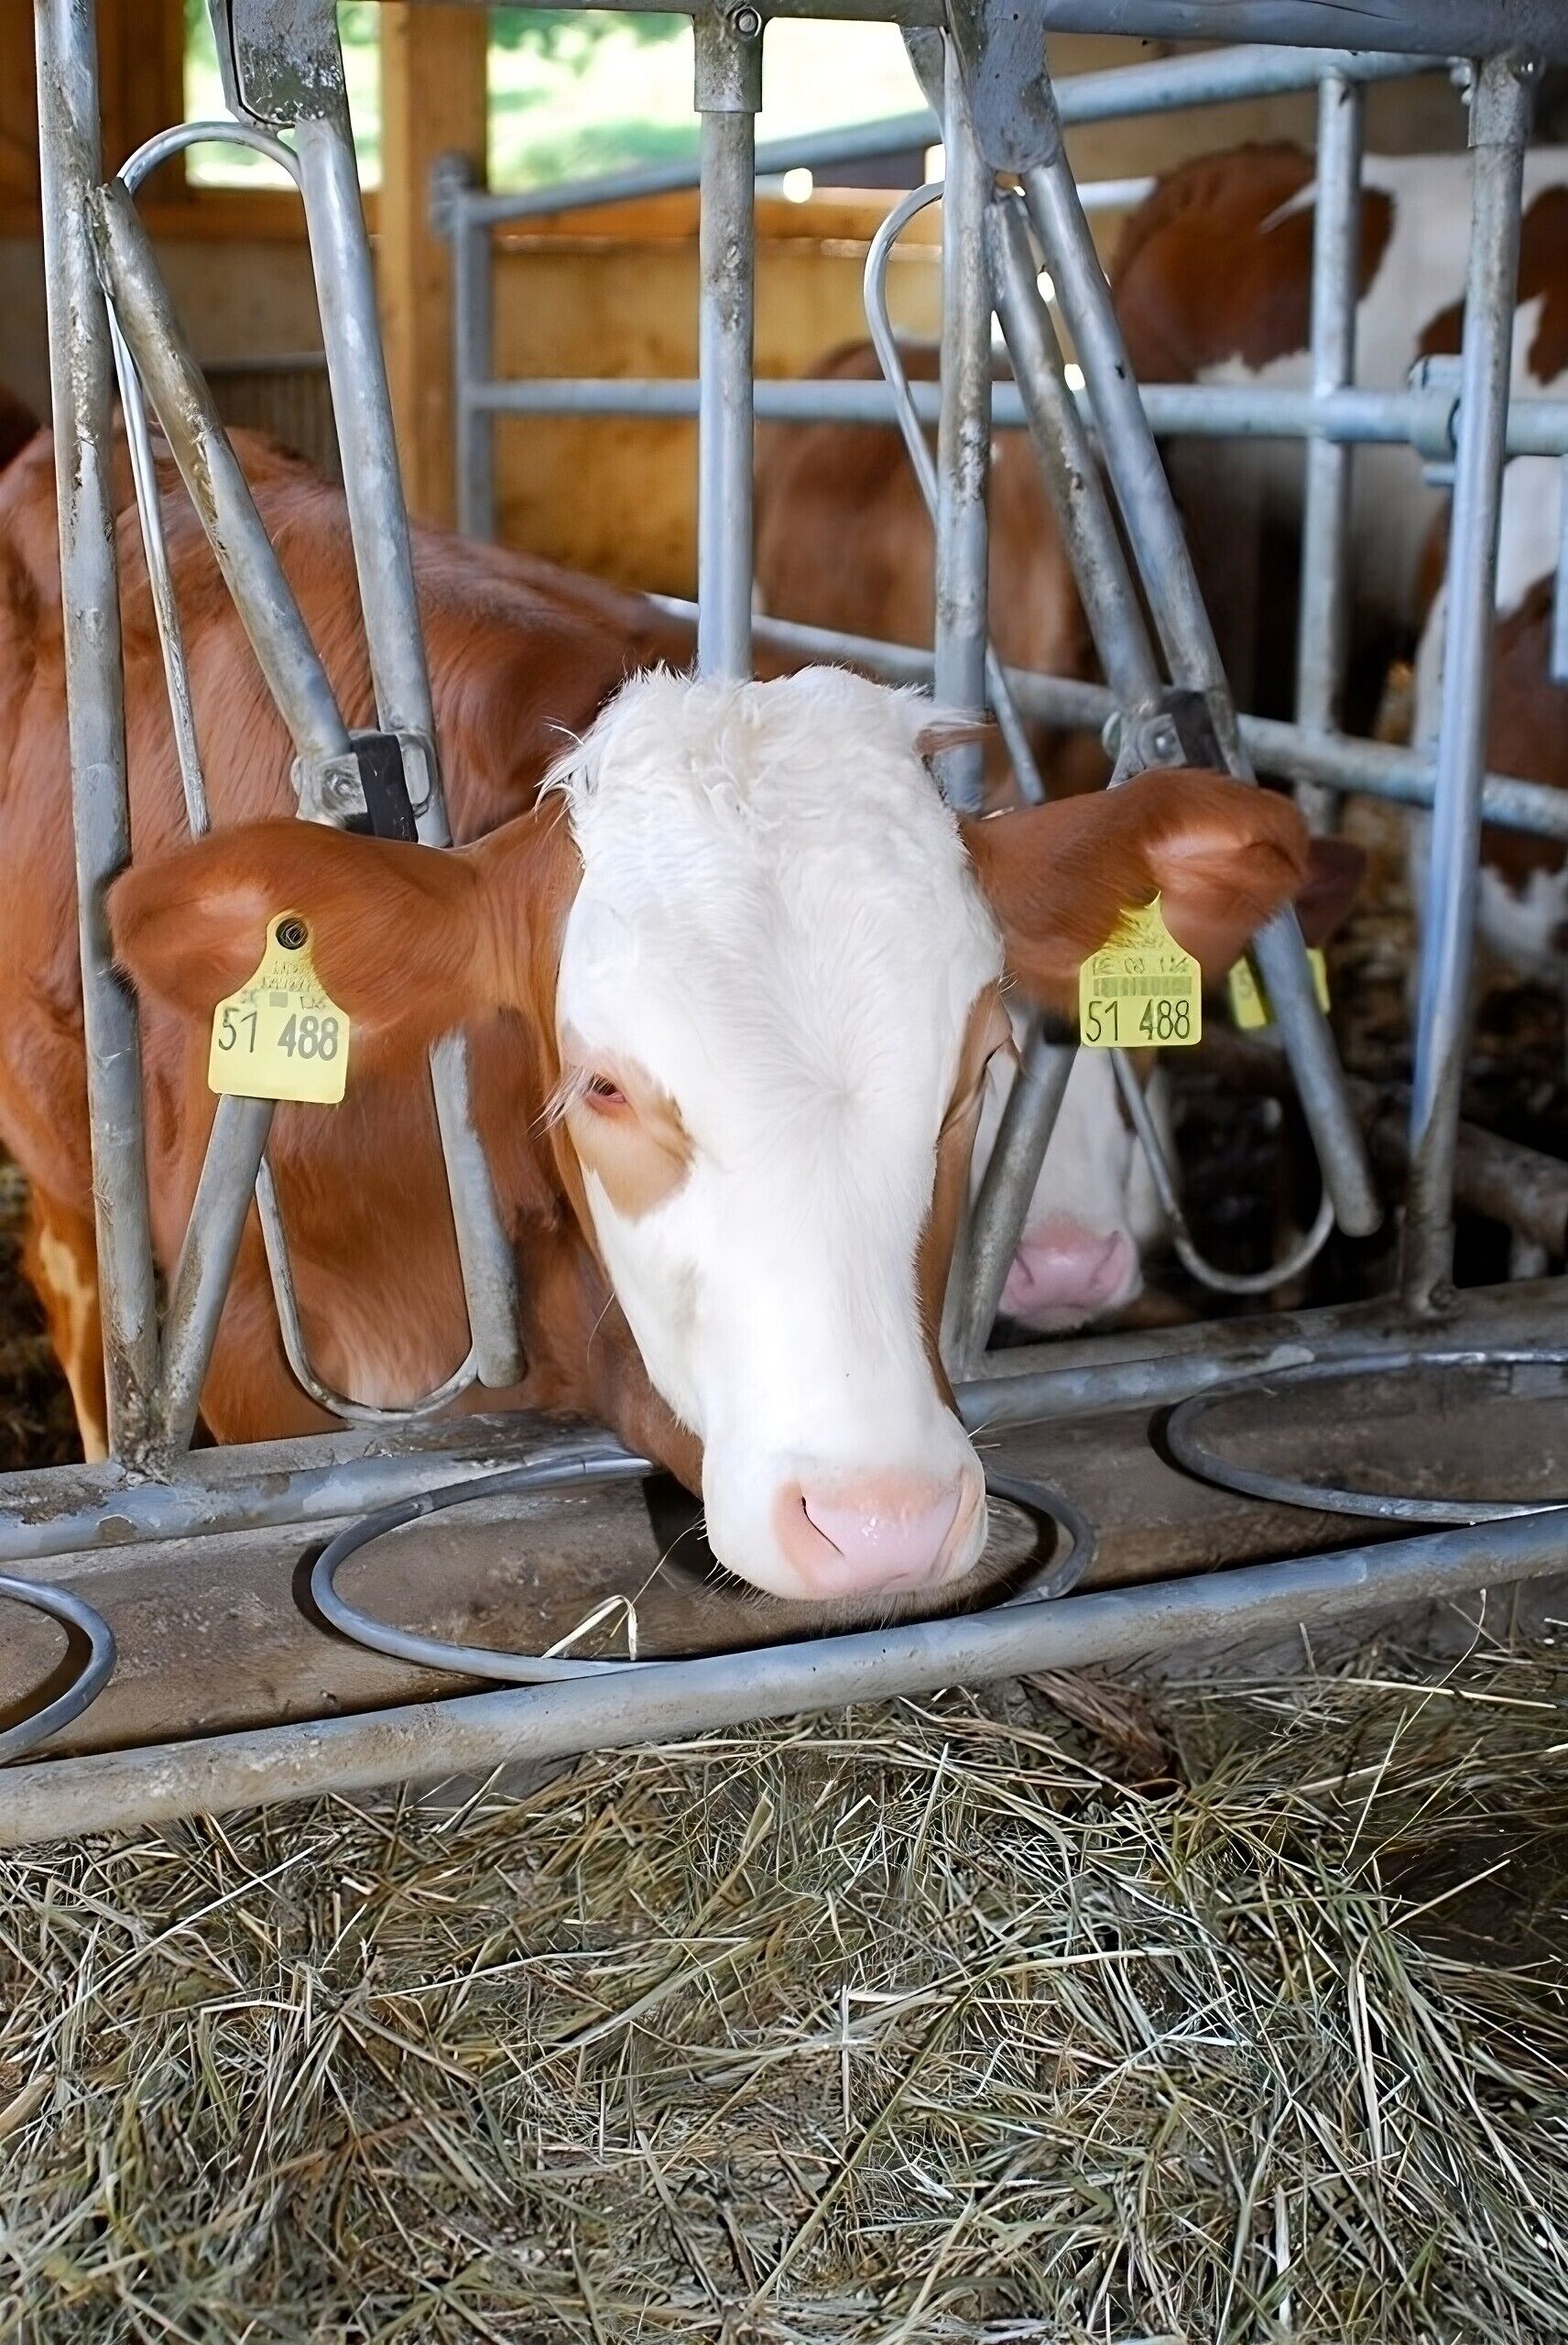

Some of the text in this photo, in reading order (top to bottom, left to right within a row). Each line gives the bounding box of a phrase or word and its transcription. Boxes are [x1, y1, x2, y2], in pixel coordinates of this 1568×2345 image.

[218, 1007, 339, 1061] 51 488
[1085, 998, 1191, 1042] 51 488
